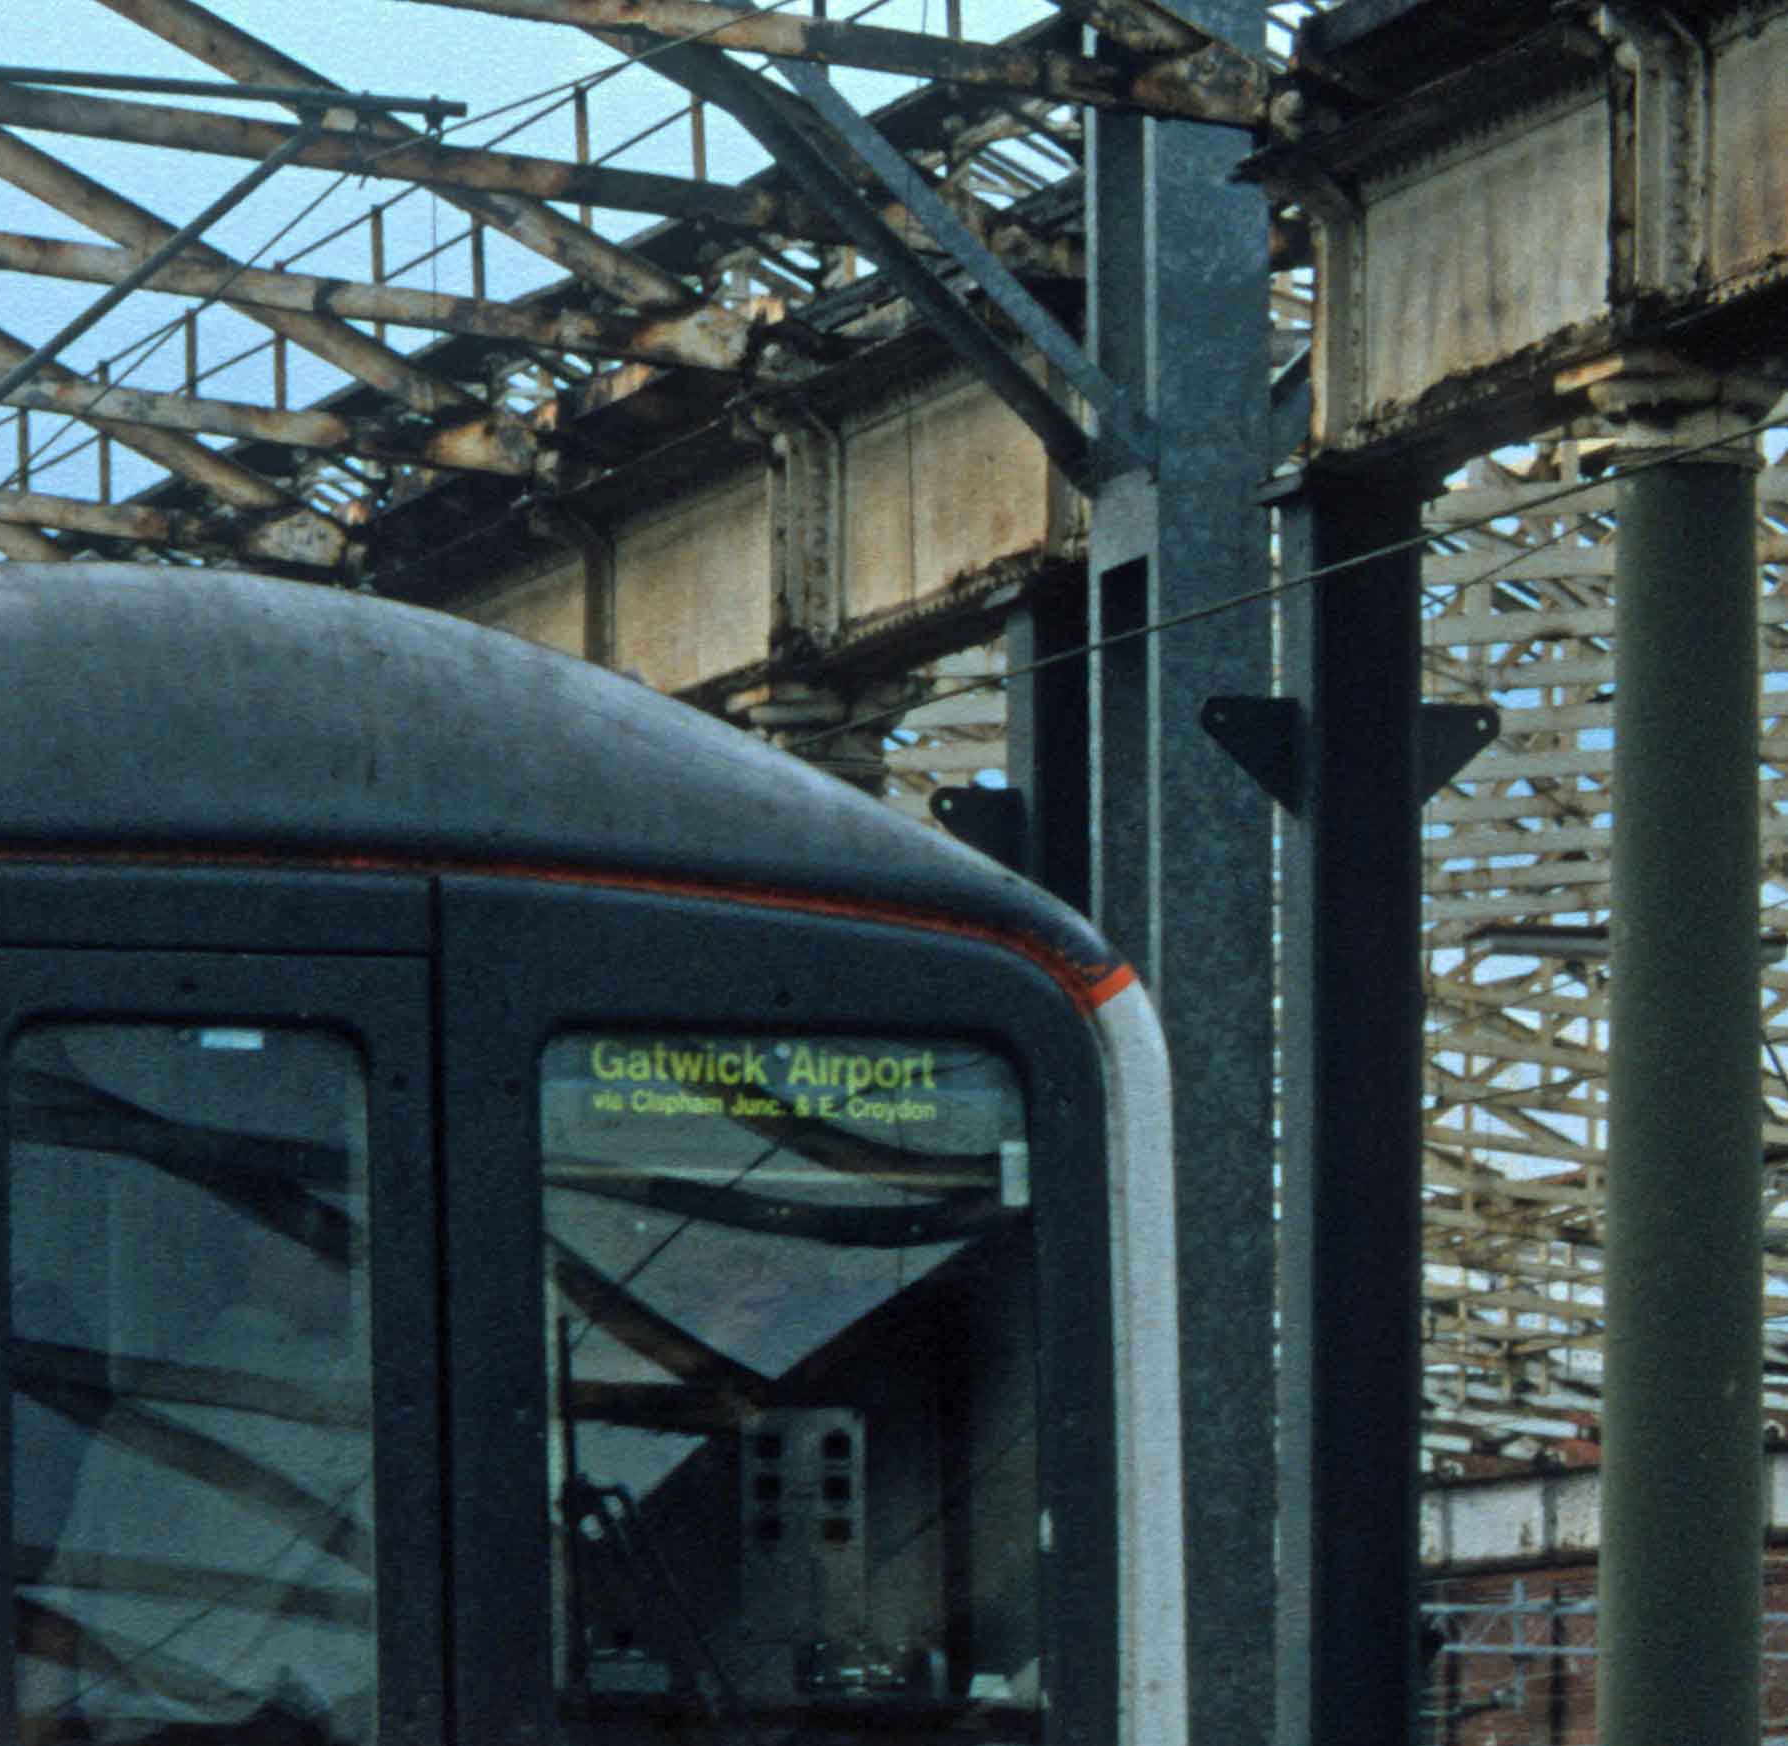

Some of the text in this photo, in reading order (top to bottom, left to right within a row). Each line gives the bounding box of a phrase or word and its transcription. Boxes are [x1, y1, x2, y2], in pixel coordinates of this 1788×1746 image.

[589, 1039, 936, 1095] Gatwick Airport
[592, 1089, 937, 1124] via Clapham Junc. & E. Croydon
